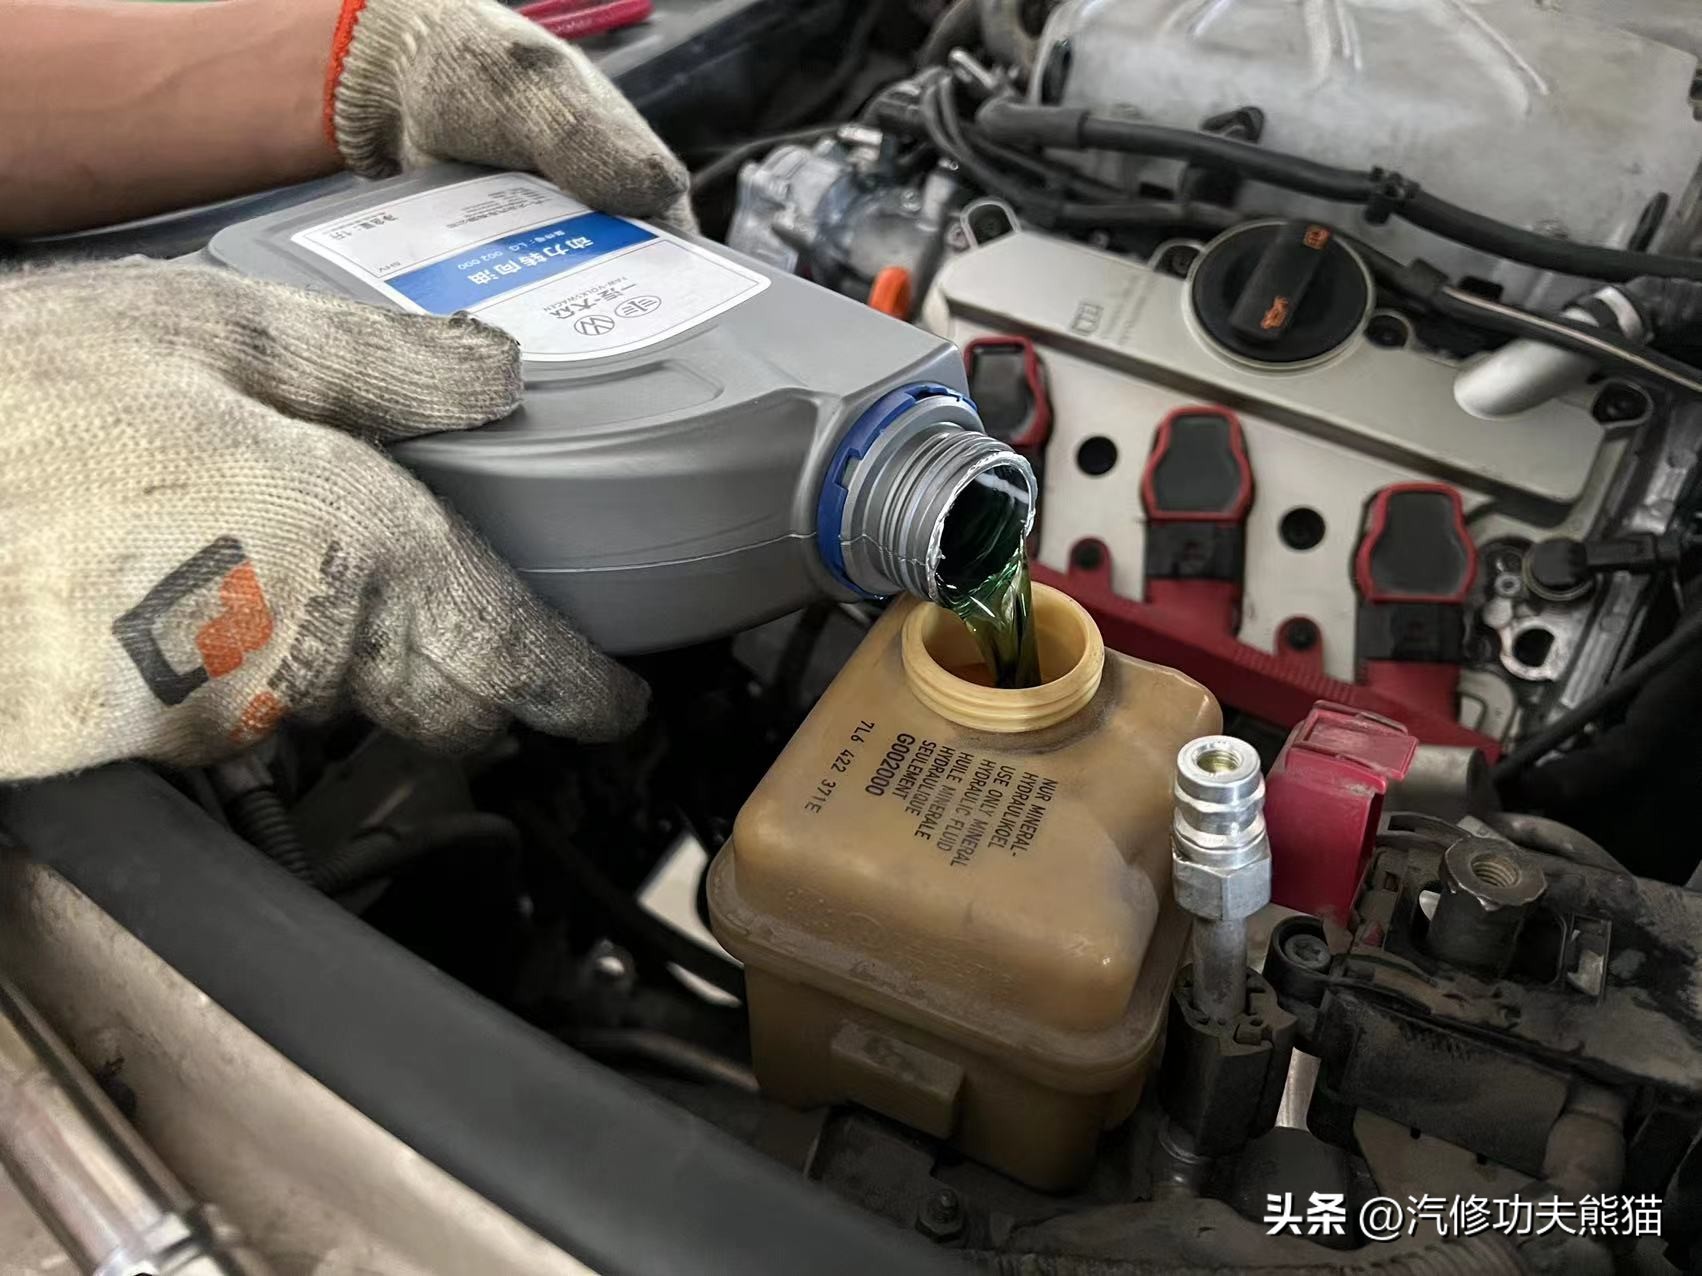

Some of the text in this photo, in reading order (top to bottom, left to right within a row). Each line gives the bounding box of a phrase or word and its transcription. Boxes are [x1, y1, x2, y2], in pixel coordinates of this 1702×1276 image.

[467, 236, 594, 285] 动力转向油
[804, 720, 875, 814] 7L6 422 371E
[864, 733, 916, 797] G002000
[892, 740, 937, 800] SEULEMENT
[905, 746, 956, 816] HYDRAULIQUE
[914, 752, 974, 840] HUILE MINERALE
[937, 759, 997, 852] HYDRAULIC FLUID
[950, 765, 1016, 866] USE ONLY MINERAL
[987, 772, 1039, 848] HYDRAULIKOEL
[1010, 777, 1057, 857] NUR MINERAL-
